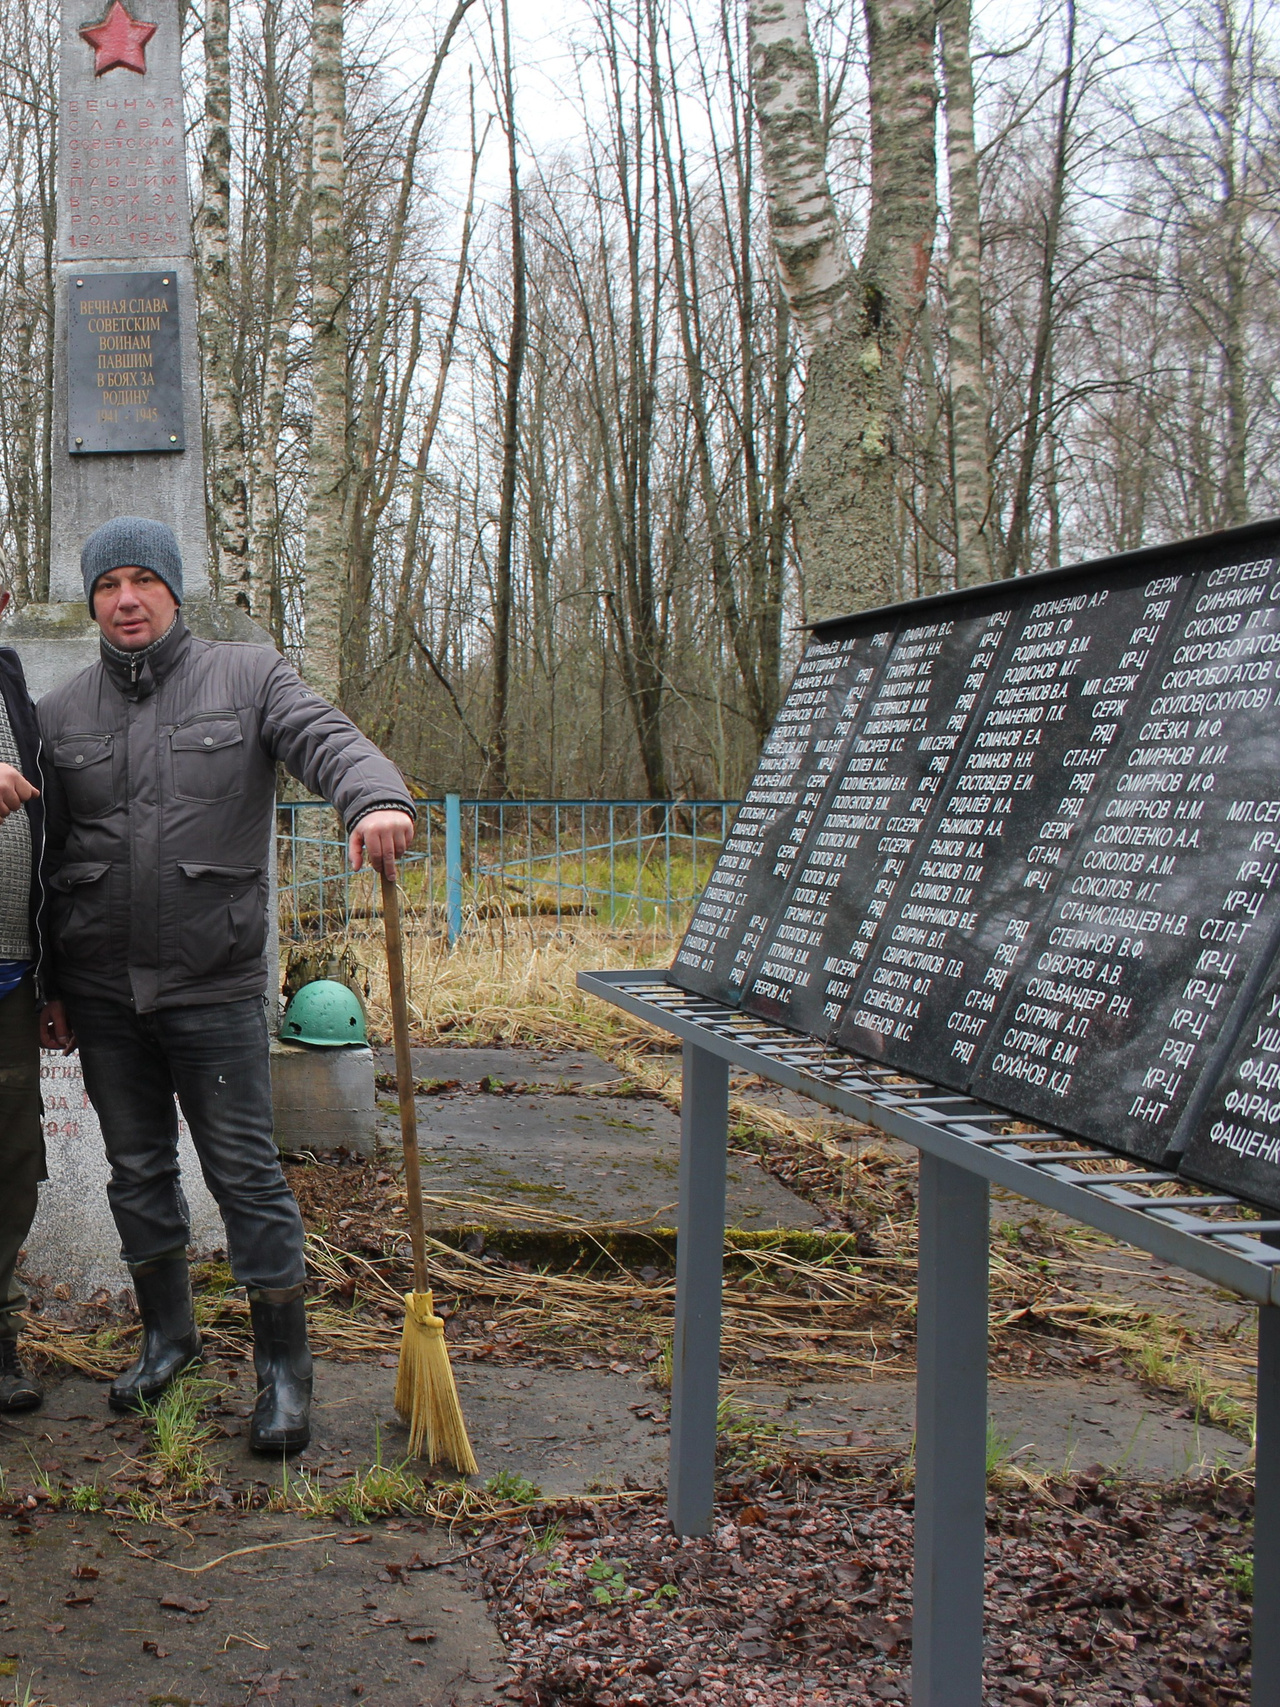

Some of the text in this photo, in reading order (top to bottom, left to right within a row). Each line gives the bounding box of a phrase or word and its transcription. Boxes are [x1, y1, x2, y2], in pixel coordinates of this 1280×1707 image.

[70, 98, 174, 111] ВЕЧНАЯ
[69, 118, 173, 131] СЛАВА
[69, 137, 173, 150] СОВЕТСКИМ
[71, 156, 175, 169] ВОИНАМ
[71, 175, 176, 188] ПАВШИМ
[70, 194, 174, 207] В БОЯХ ЗА
[71, 213, 176, 226] РОДИНУ
[69, 232, 176, 247] 1941-1945
[80, 299, 168, 315] ВЕЧНАЯ СЛАВА
[89, 316, 160, 333] СОВЕТСКИМ
[100, 335, 151, 350] ВОИНАМ
[99, 354, 153, 369] ПАВШИМ
[97, 372, 155, 387] В БОЯХ ЗА
[103, 390, 149, 406] РОДИНУ
[135, 408, 158, 422] 1945
[1207, 558, 1272, 588] СЕРГЕЕВ
[1030, 594, 1087, 620] РОГАЧЕНКО
[1144, 574, 1183, 598] СЕРЖ
[1196, 585, 1265, 613] СИНЯКИН
[1184, 615, 1240, 640] СКОКОВ
[1011, 640, 1065, 663] РОДИОНОВ
[1129, 625, 1160, 645] КР-Ц
[1105, 800, 1171, 820] СМИРНОВ
[1083, 851, 1145, 875] СОКОЛОВ
[1060, 902, 1162, 933] СТАНИСЛАВЦЕВ
[1199, 919, 1252, 945] СТ.Л-Т
[1037, 952, 1095, 980] СУВОРОВ
[1183, 979, 1223, 1010] КР-Ц
[992, 1053, 1046, 1086] СУХАНОВ
[1128, 1096, 1169, 1124] Л-НТ
[40, 1122, 79, 1138] 941
